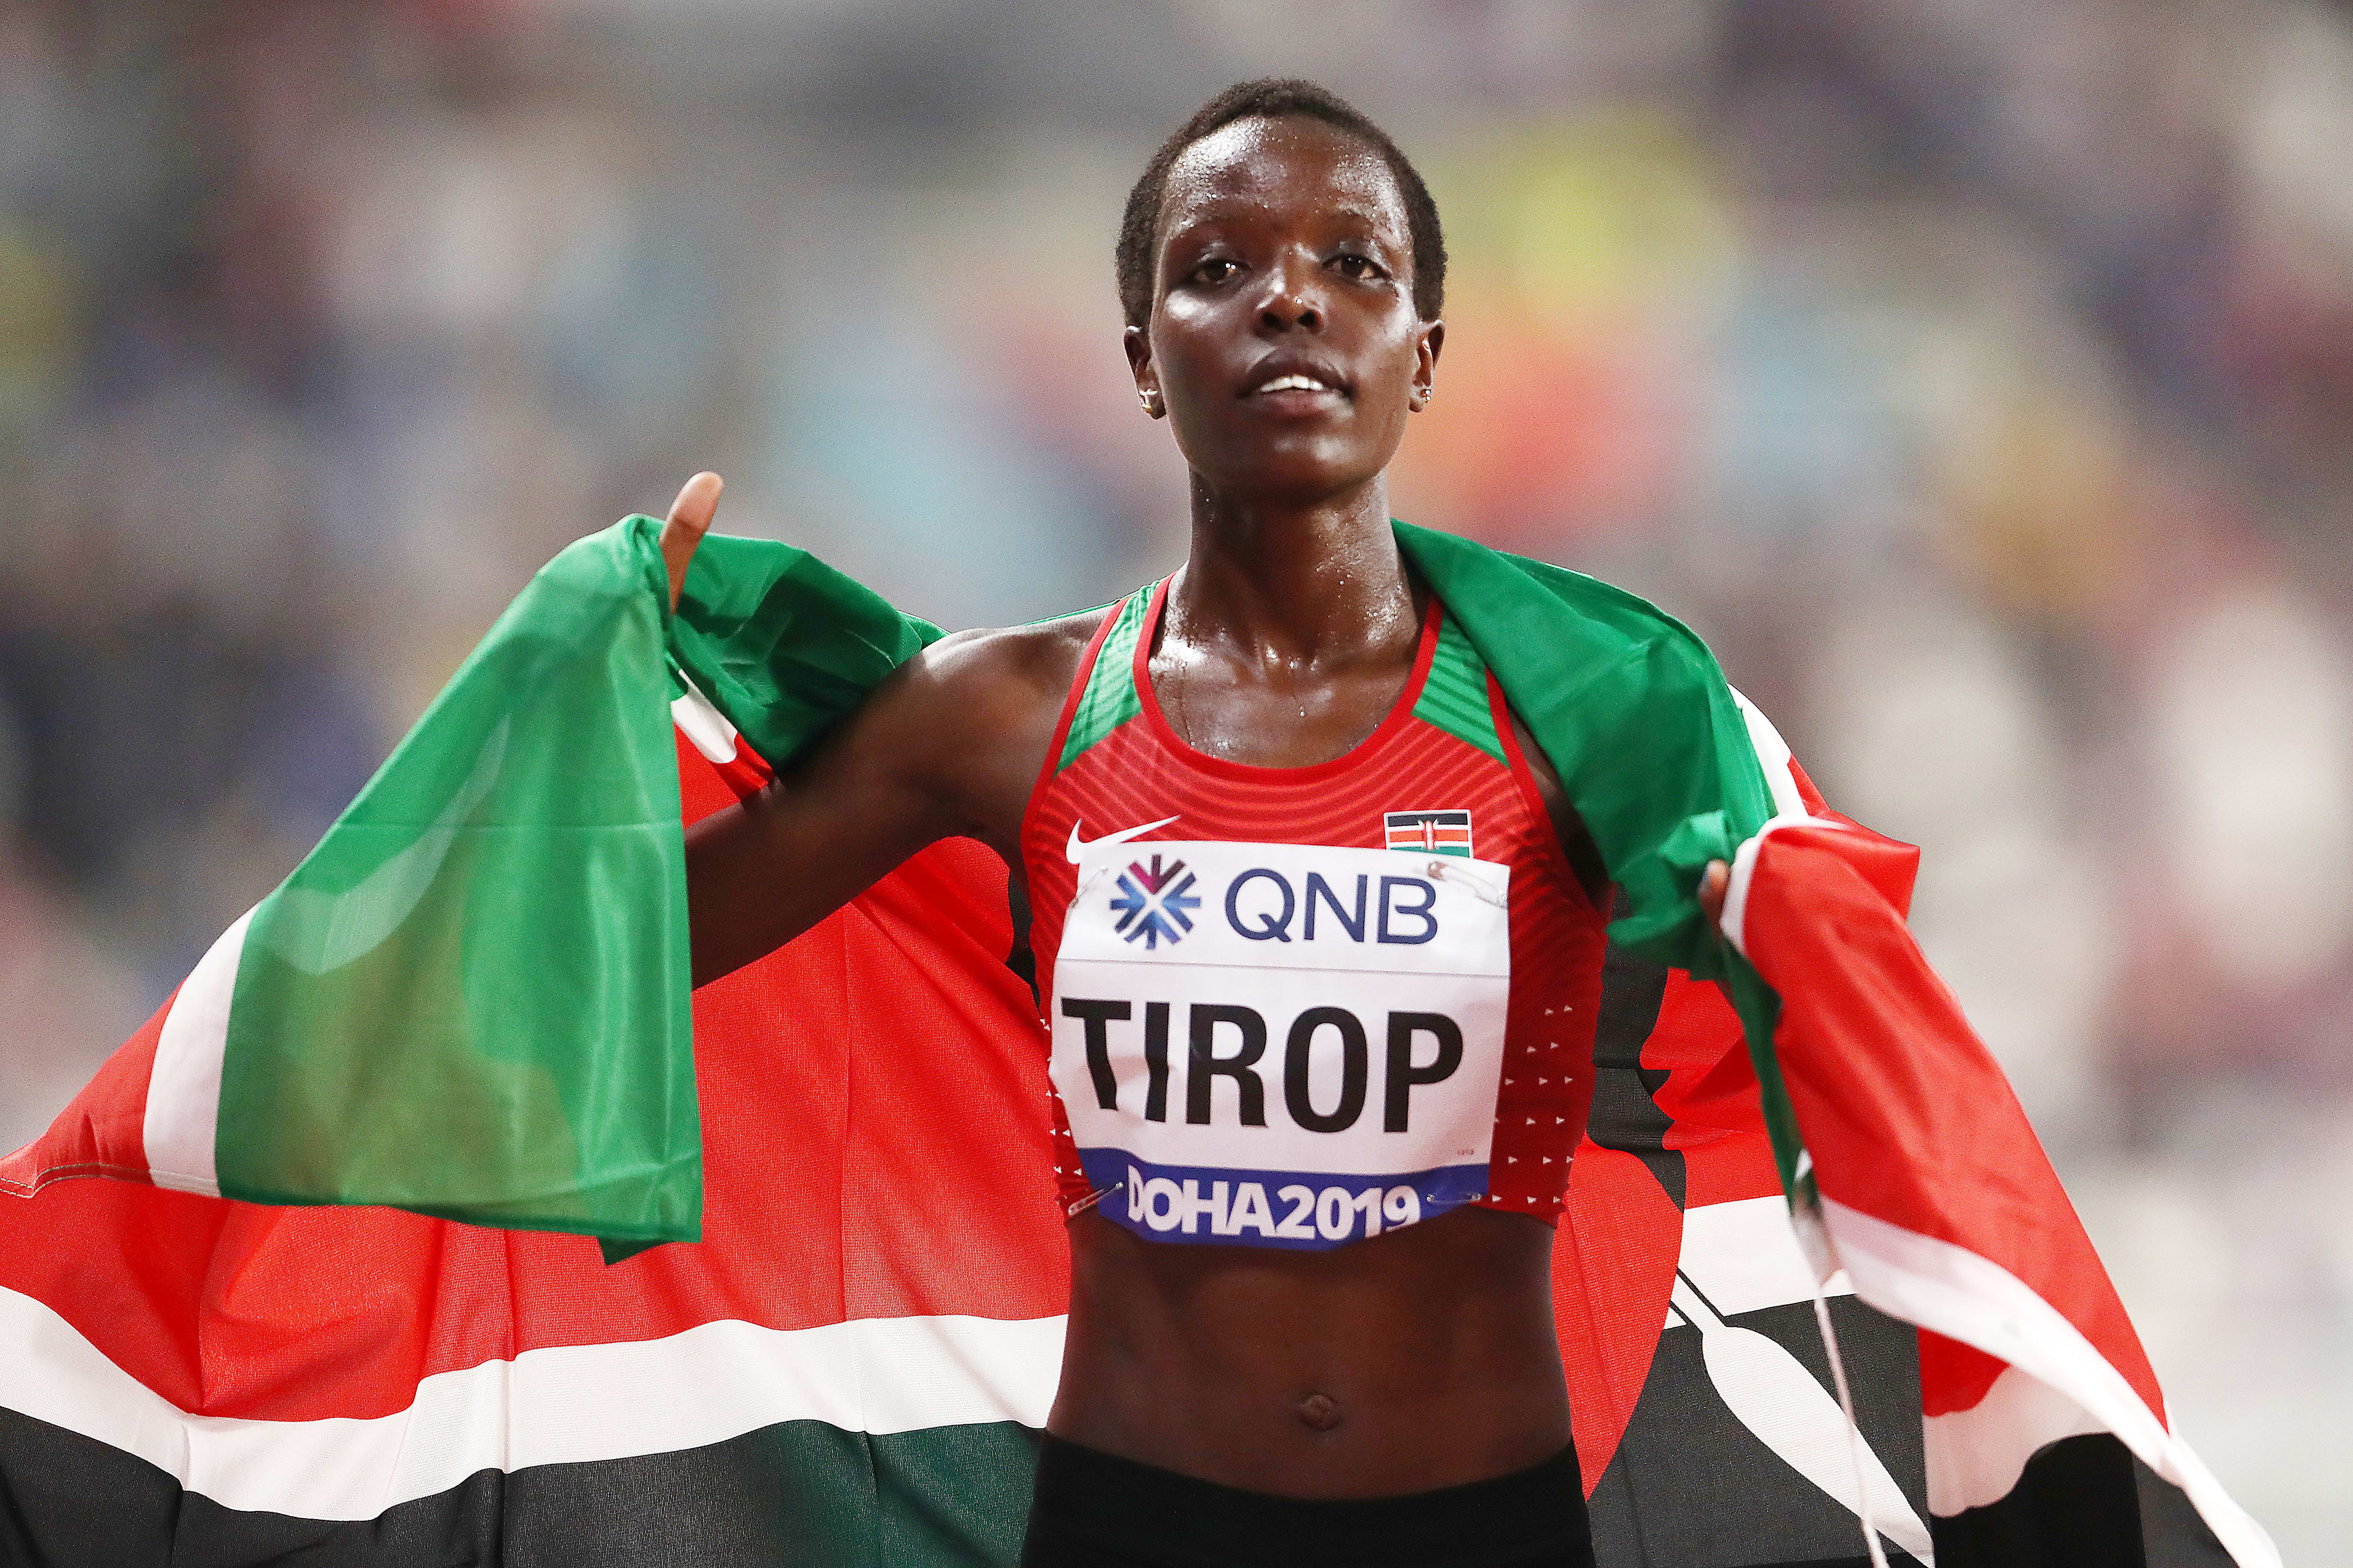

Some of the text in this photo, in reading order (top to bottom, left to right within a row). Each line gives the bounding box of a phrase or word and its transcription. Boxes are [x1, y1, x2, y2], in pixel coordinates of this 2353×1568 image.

[1225, 868, 1438, 945] QNB
[1061, 997, 1464, 1133] TIROP
[1128, 1165, 1421, 1240] DOHA2019
